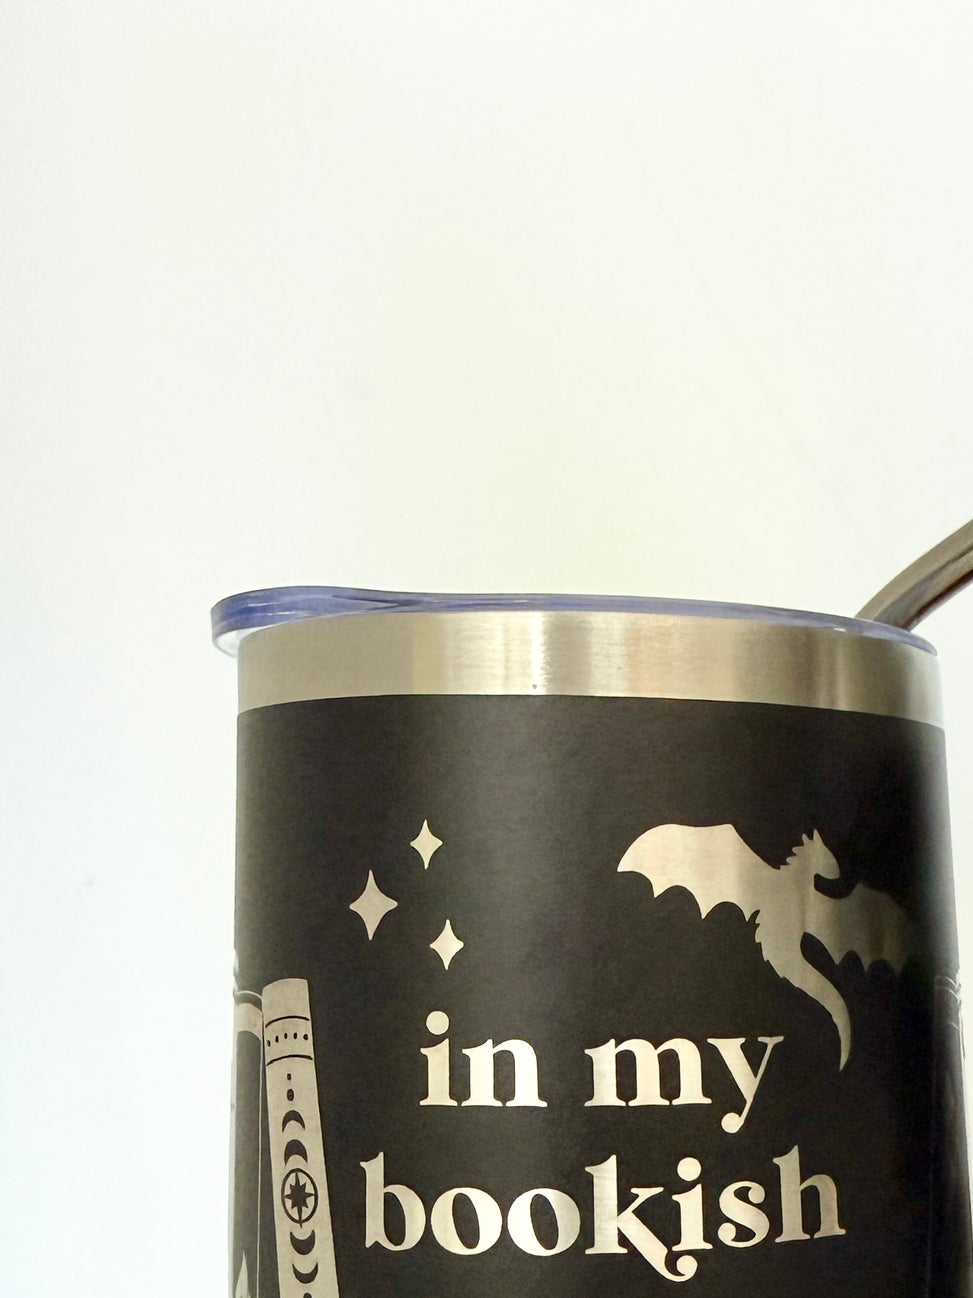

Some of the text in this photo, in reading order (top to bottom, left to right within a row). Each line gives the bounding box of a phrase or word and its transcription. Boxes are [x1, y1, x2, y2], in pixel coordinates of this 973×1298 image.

[419, 1010, 784, 1134] in my
[360, 1146, 846, 1283] bookish
